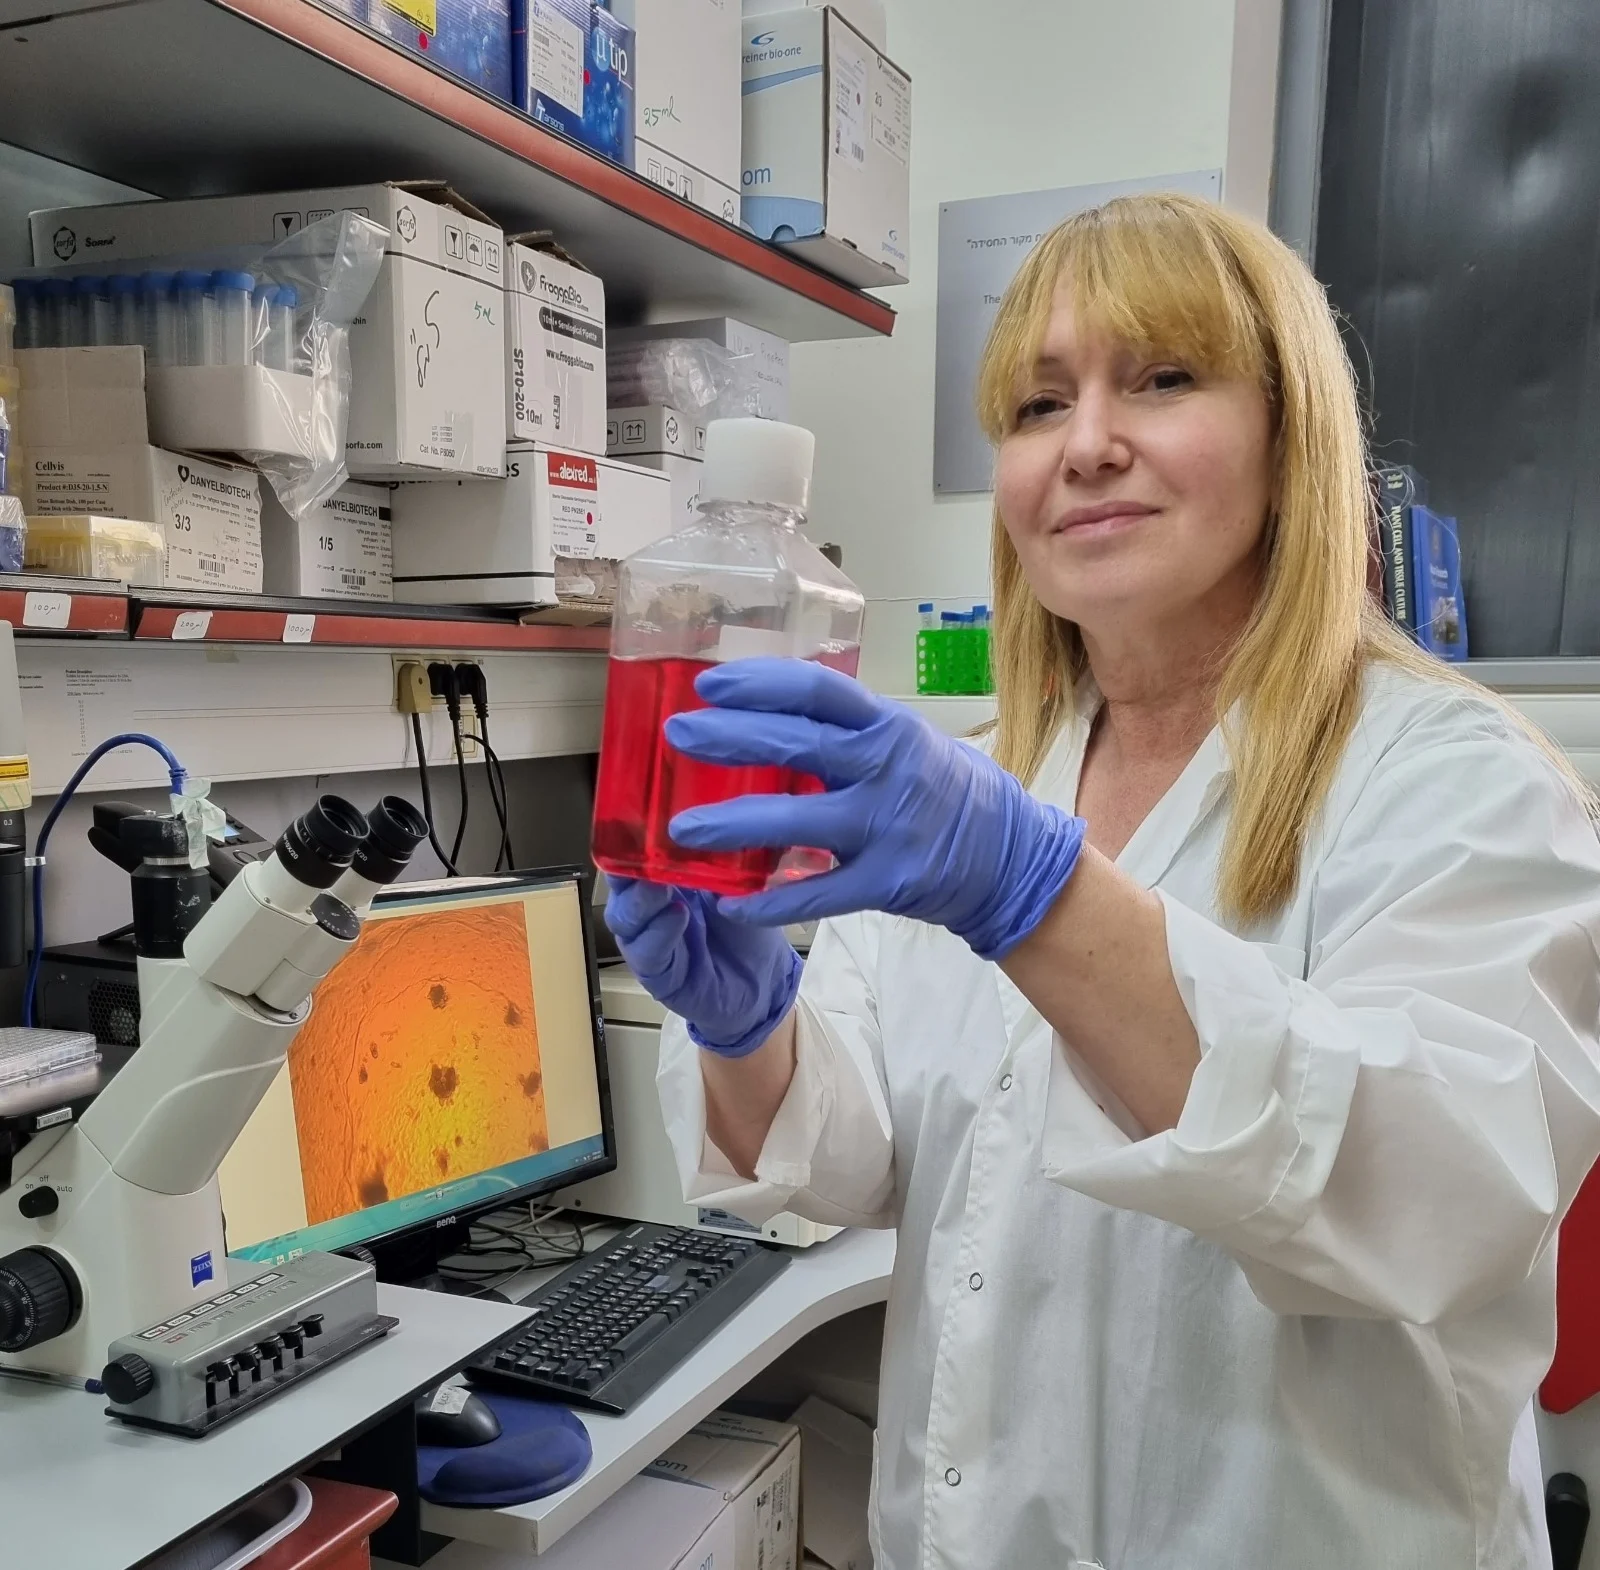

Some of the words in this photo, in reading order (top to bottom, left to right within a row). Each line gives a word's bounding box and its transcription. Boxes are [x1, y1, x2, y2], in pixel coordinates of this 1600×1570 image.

[769, 46, 802, 60] bio-one
[398, 217, 415, 231] sorfa
[983, 294, 1001, 305] The
[513, 348, 525, 421] SP10-200
[525, 408, 543, 425] 10ml
[35, 461, 65, 471] Cellvis
[37, 483, 62, 491] Product
[190, 474, 251, 500] DANYELBIOTECH
[174, 513, 192, 532] 3/3
[318, 535, 334, 551] 1/5
[39, 1175, 50, 1183] off
[56, 1185, 73, 1193] auto
[192, 1259, 213, 1274] ZEISS
